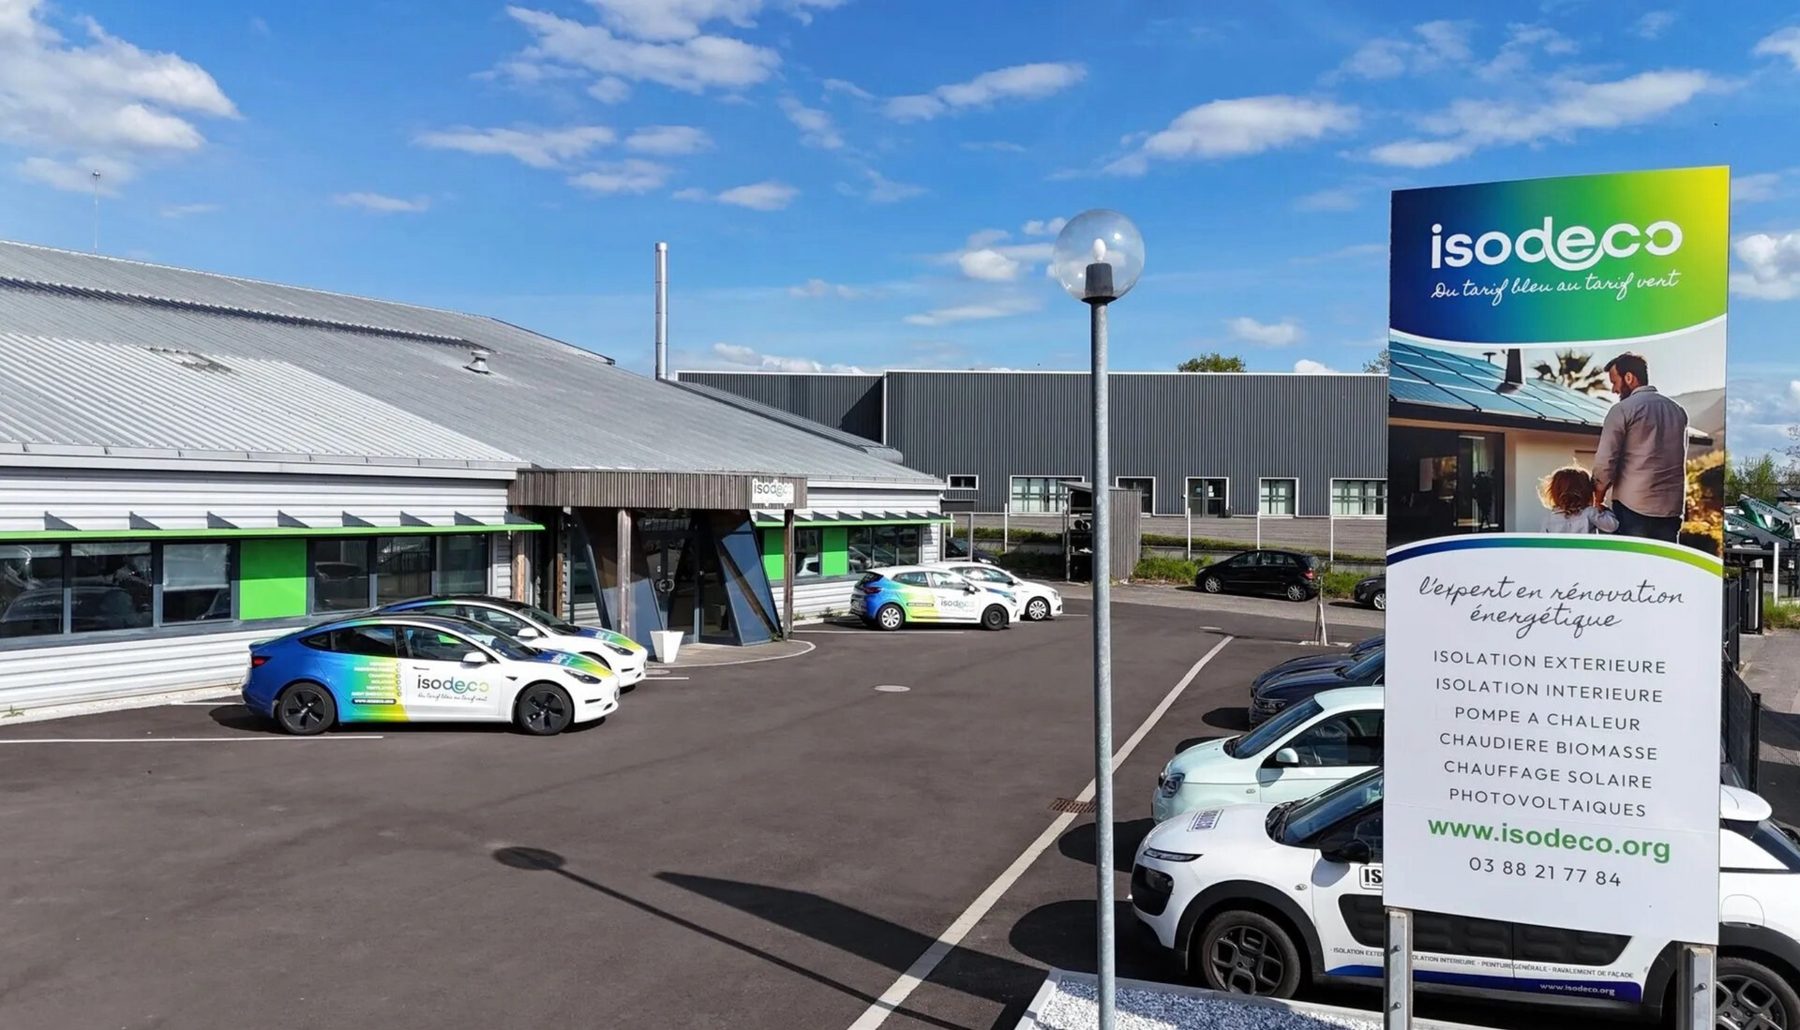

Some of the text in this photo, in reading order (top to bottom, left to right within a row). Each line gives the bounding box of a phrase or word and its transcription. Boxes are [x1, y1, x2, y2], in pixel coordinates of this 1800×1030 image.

[1431, 216, 1683, 271] isodeco
[1431, 282, 1459, 298] Du
[1463, 279, 1508, 306] tarif
[1511, 277, 1553, 295] bleu
[1556, 281, 1582, 292] au
[1585, 272, 1634, 301] tarif
[1419, 575, 1684, 606] l'expert en rénovation
[1470, 602, 1622, 639] énergétique
[1433, 649, 1666, 675] ISOLATION EXTERIEURE
[1436, 677, 1663, 703] ISOLATION INTERIEURE
[1455, 706, 1641, 732] POMPE A CHALEUR
[1439, 732, 1658, 761] CHAUDIERE BIOMASSE
[1443, 760, 1652, 789] CHAUFFAGE SOLAIRE
[1449, 787, 1646, 818] PHOTOVOLTAIQUES
[1427, 819, 1671, 864] www.isodeco.org
[1468, 856, 1622, 887] 03 88 21 77 84
[1333, 948, 1365, 956] ISOLATION
[1440, 957, 1476, 966] INTERIEURE
[1552, 966, 1596, 976] RAVALEMENT
[1607, 969, 1634, 979] FAÇADE
[1539, 982, 1616, 997] www.isodeco.org
